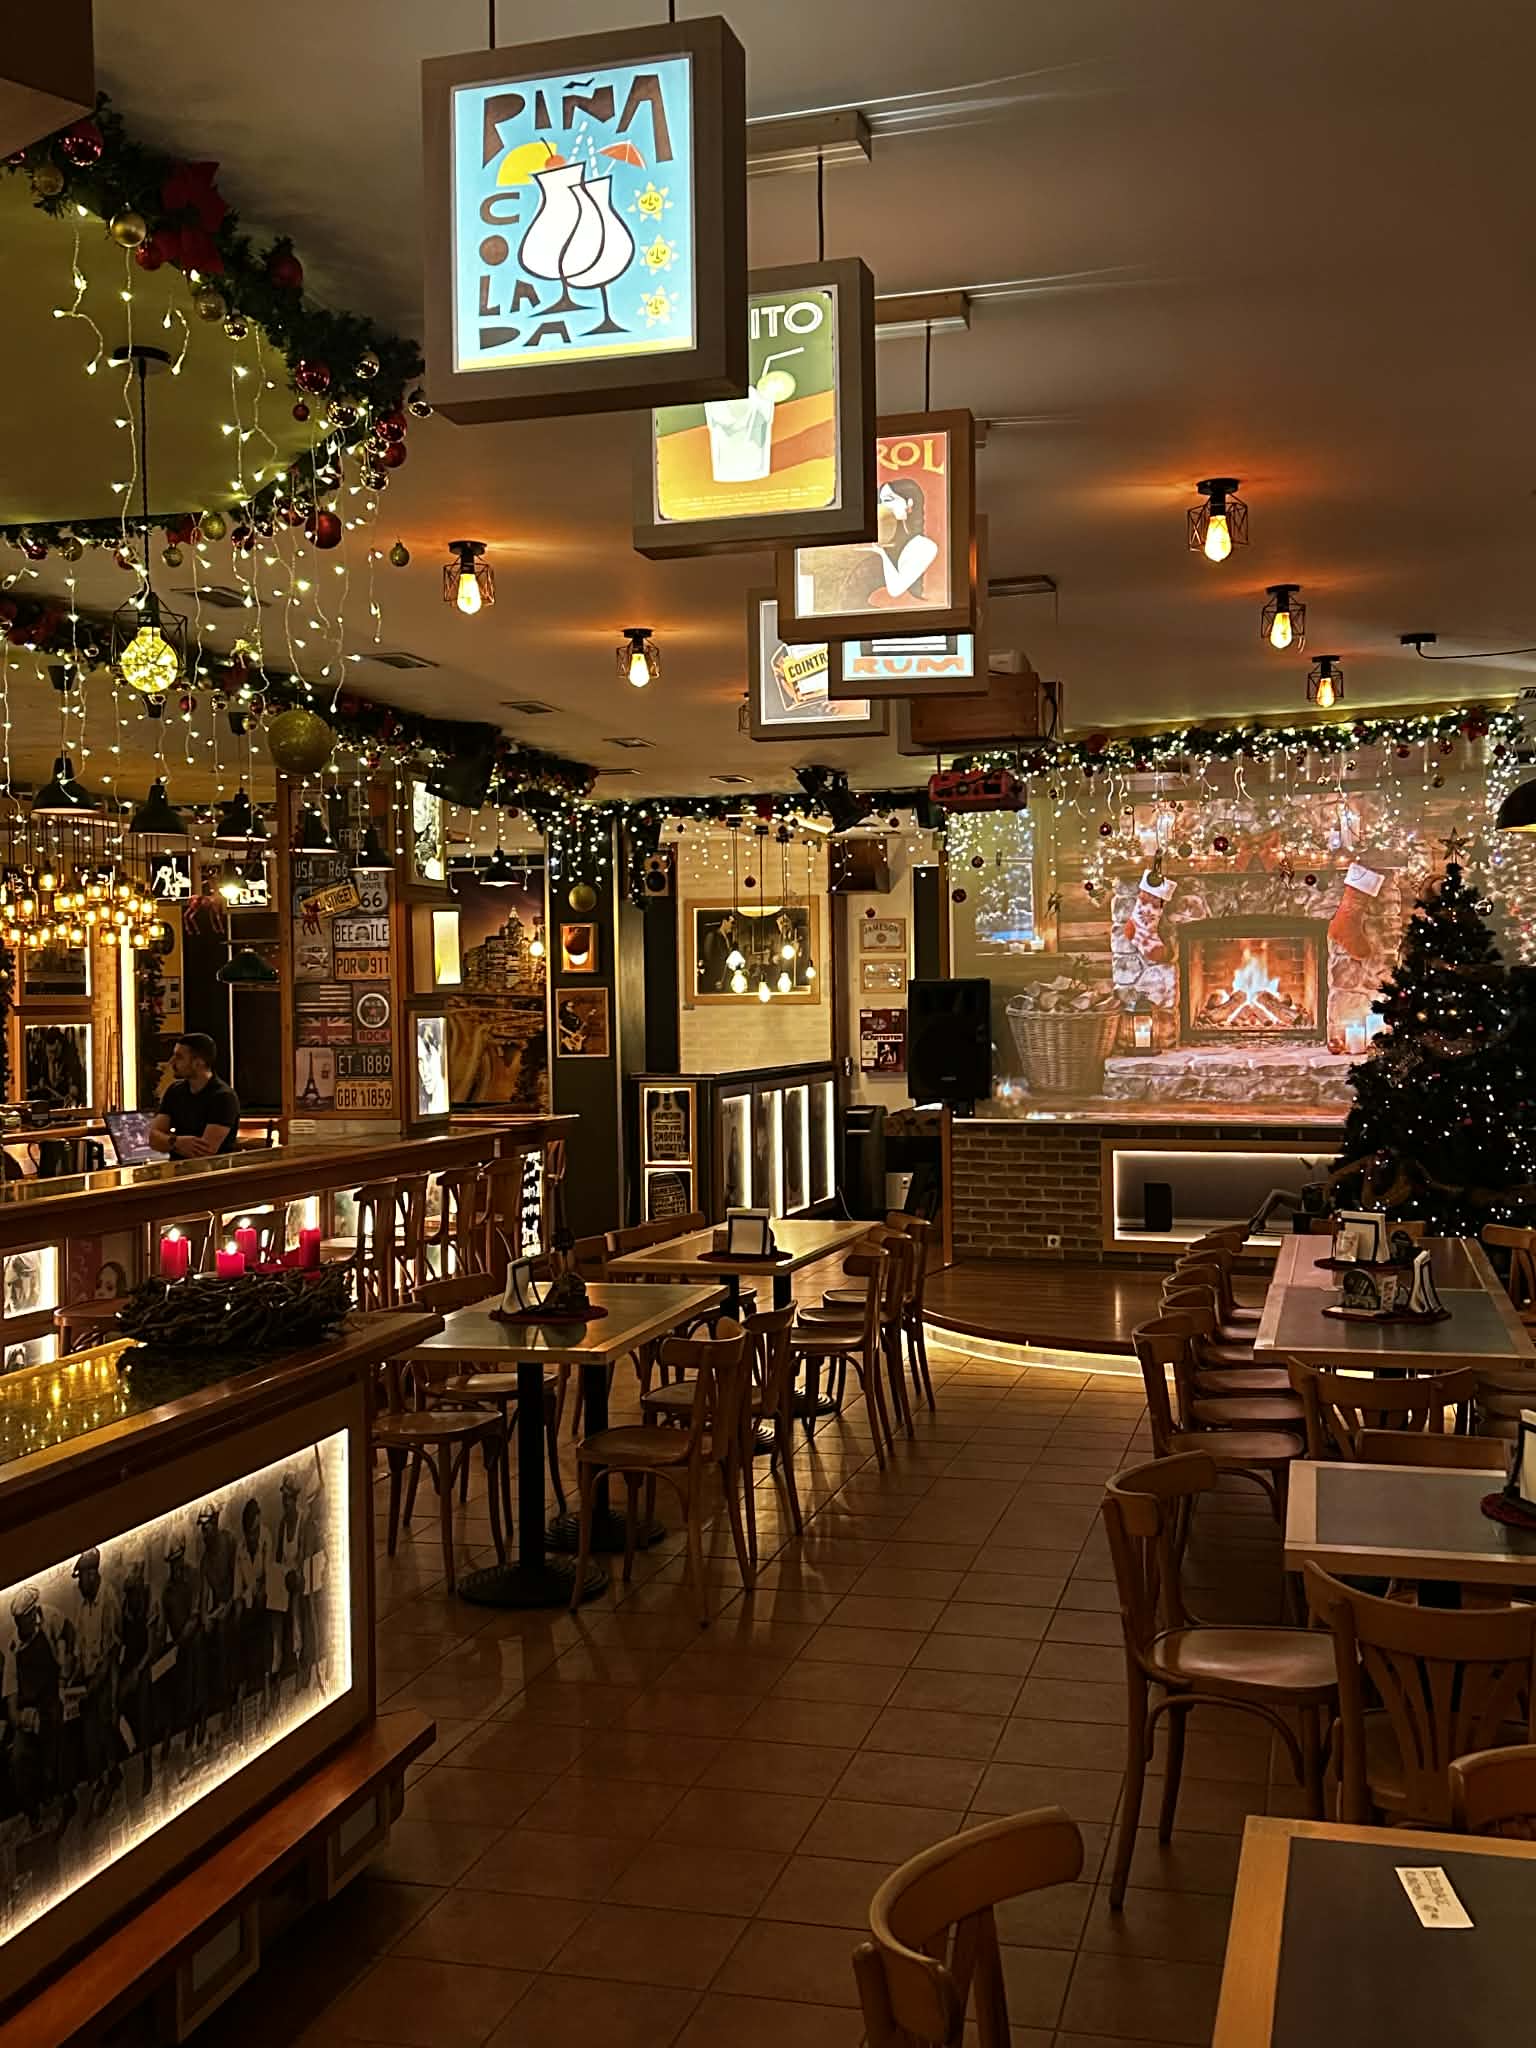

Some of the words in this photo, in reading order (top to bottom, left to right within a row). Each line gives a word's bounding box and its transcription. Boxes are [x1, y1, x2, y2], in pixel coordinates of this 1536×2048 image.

[482, 74, 673, 169] PIÑA
[853, 656, 965, 674] RUM
[295, 860, 313, 878] USA
[328, 860, 349, 878] R66
[361, 890, 382, 908] 66
[336, 957, 357, 976] POR
[370, 957, 389, 974] 911
[362, 1055, 391, 1073] 1889
[337, 1088, 358, 1107] GBR
